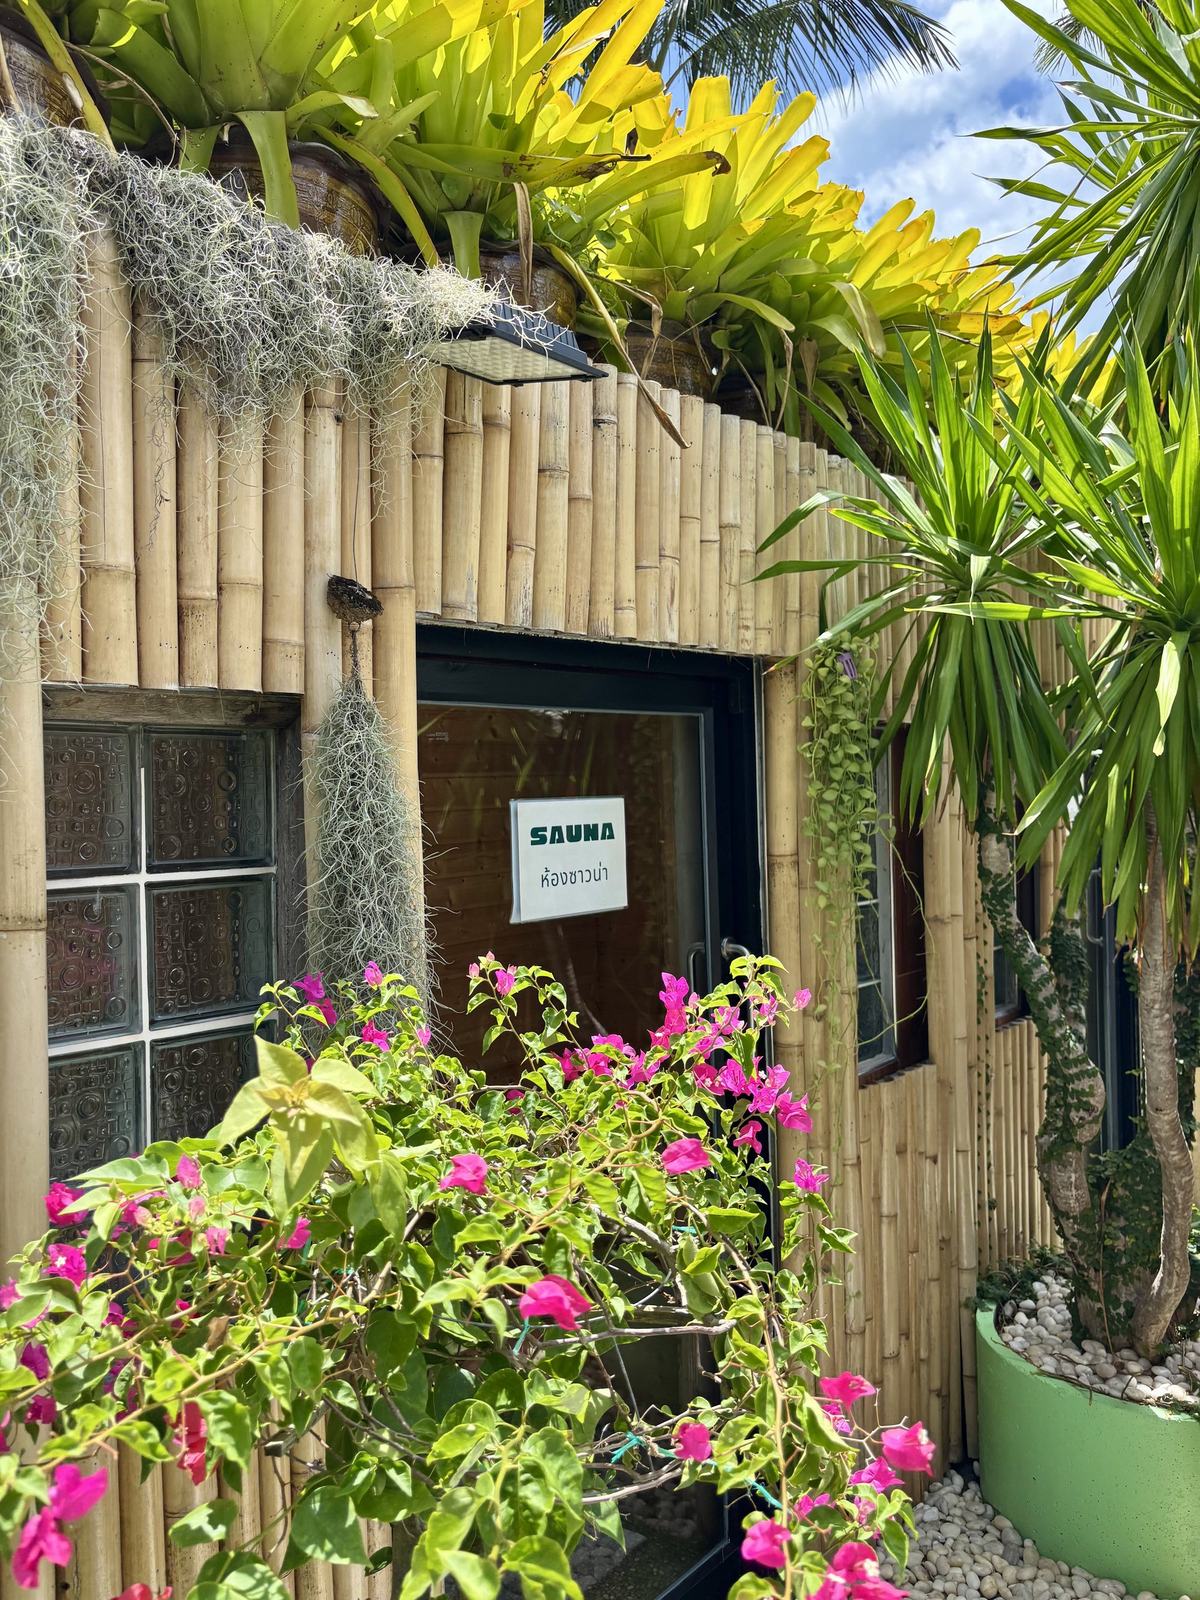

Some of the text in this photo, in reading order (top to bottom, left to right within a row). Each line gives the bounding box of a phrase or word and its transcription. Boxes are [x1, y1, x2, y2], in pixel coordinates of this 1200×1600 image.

[530, 822, 615, 846] SAUNA
[541, 861, 608, 888] ห้องซาวน่า
